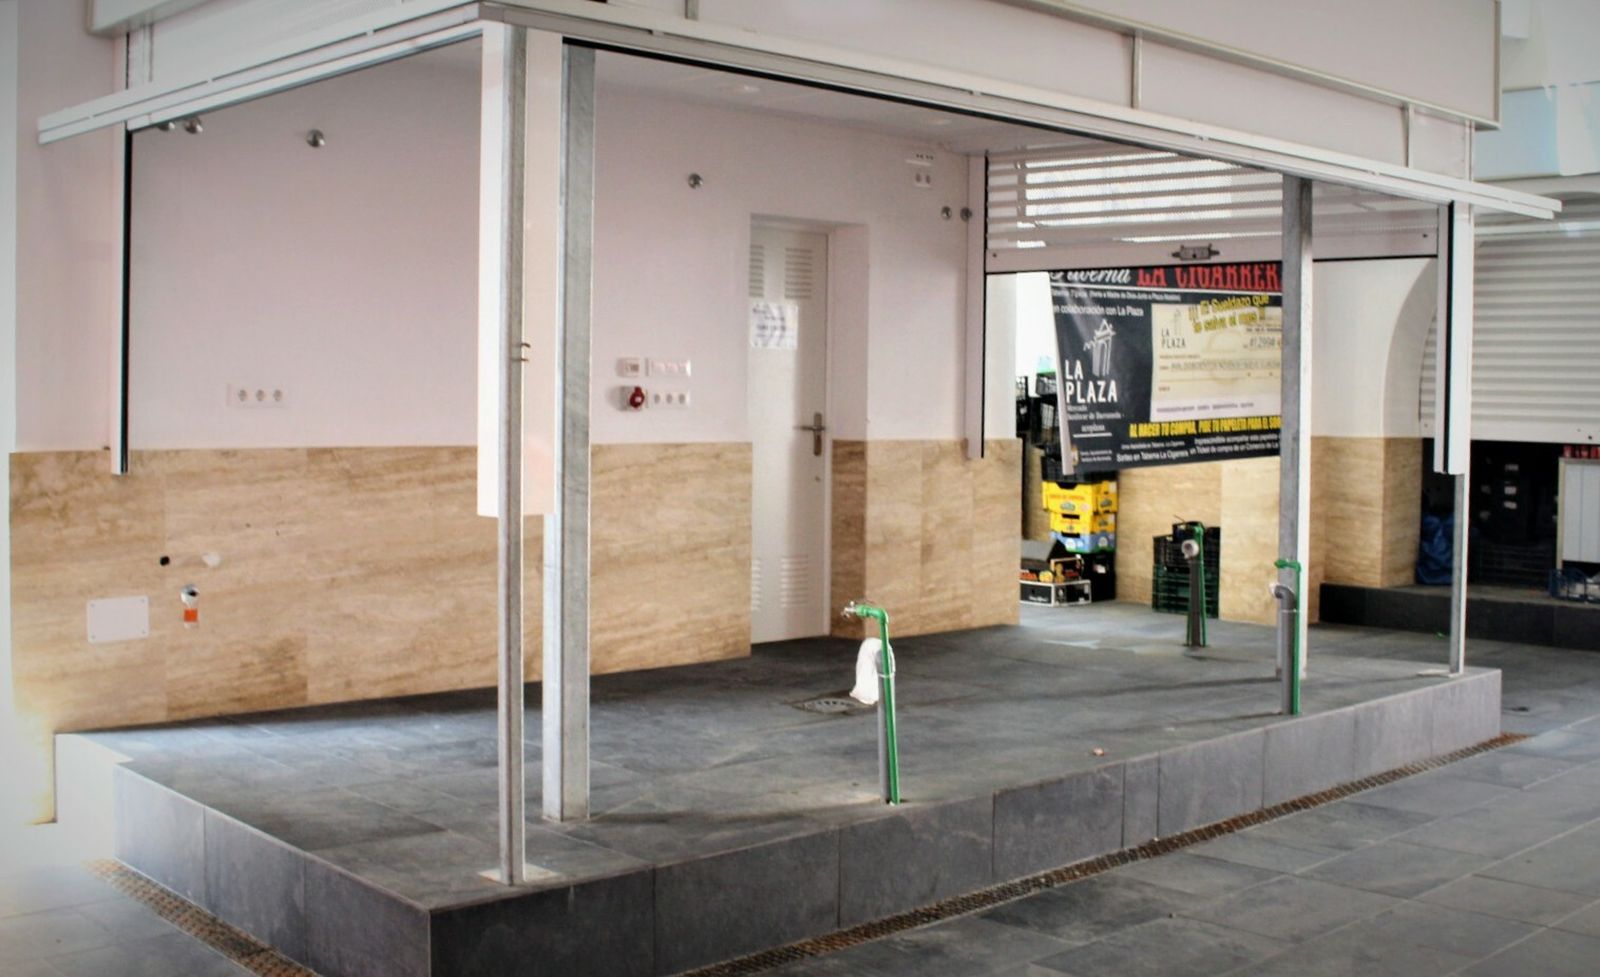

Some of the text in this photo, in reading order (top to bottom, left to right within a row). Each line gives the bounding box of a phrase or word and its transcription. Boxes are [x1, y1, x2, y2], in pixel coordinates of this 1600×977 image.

[1137, 267, 1167, 287] LA
[1252, 293, 1269, 306] que
[1061, 304, 1104, 314] colaboración
[1106, 307, 1116, 315] con
[1118, 306, 1125, 316] La
[1126, 305, 1144, 316] Plaza
[1161, 328, 1170, 338] LA
[1161, 338, 1186, 349] PLAZA
[1065, 360, 1084, 380] LA
[1065, 380, 1118, 404] PLAZA
[1129, 423, 1137, 438] AL
[1138, 422, 1160, 438] HACER
[1161, 422, 1170, 436] TU
[1248, 417, 1262, 430] PARA
[1116, 453, 1132, 462] Sorteo
[1140, 451, 1159, 460] Taberna
[1160, 451, 1166, 459] La
[1168, 450, 1188, 460] Cigarrera
